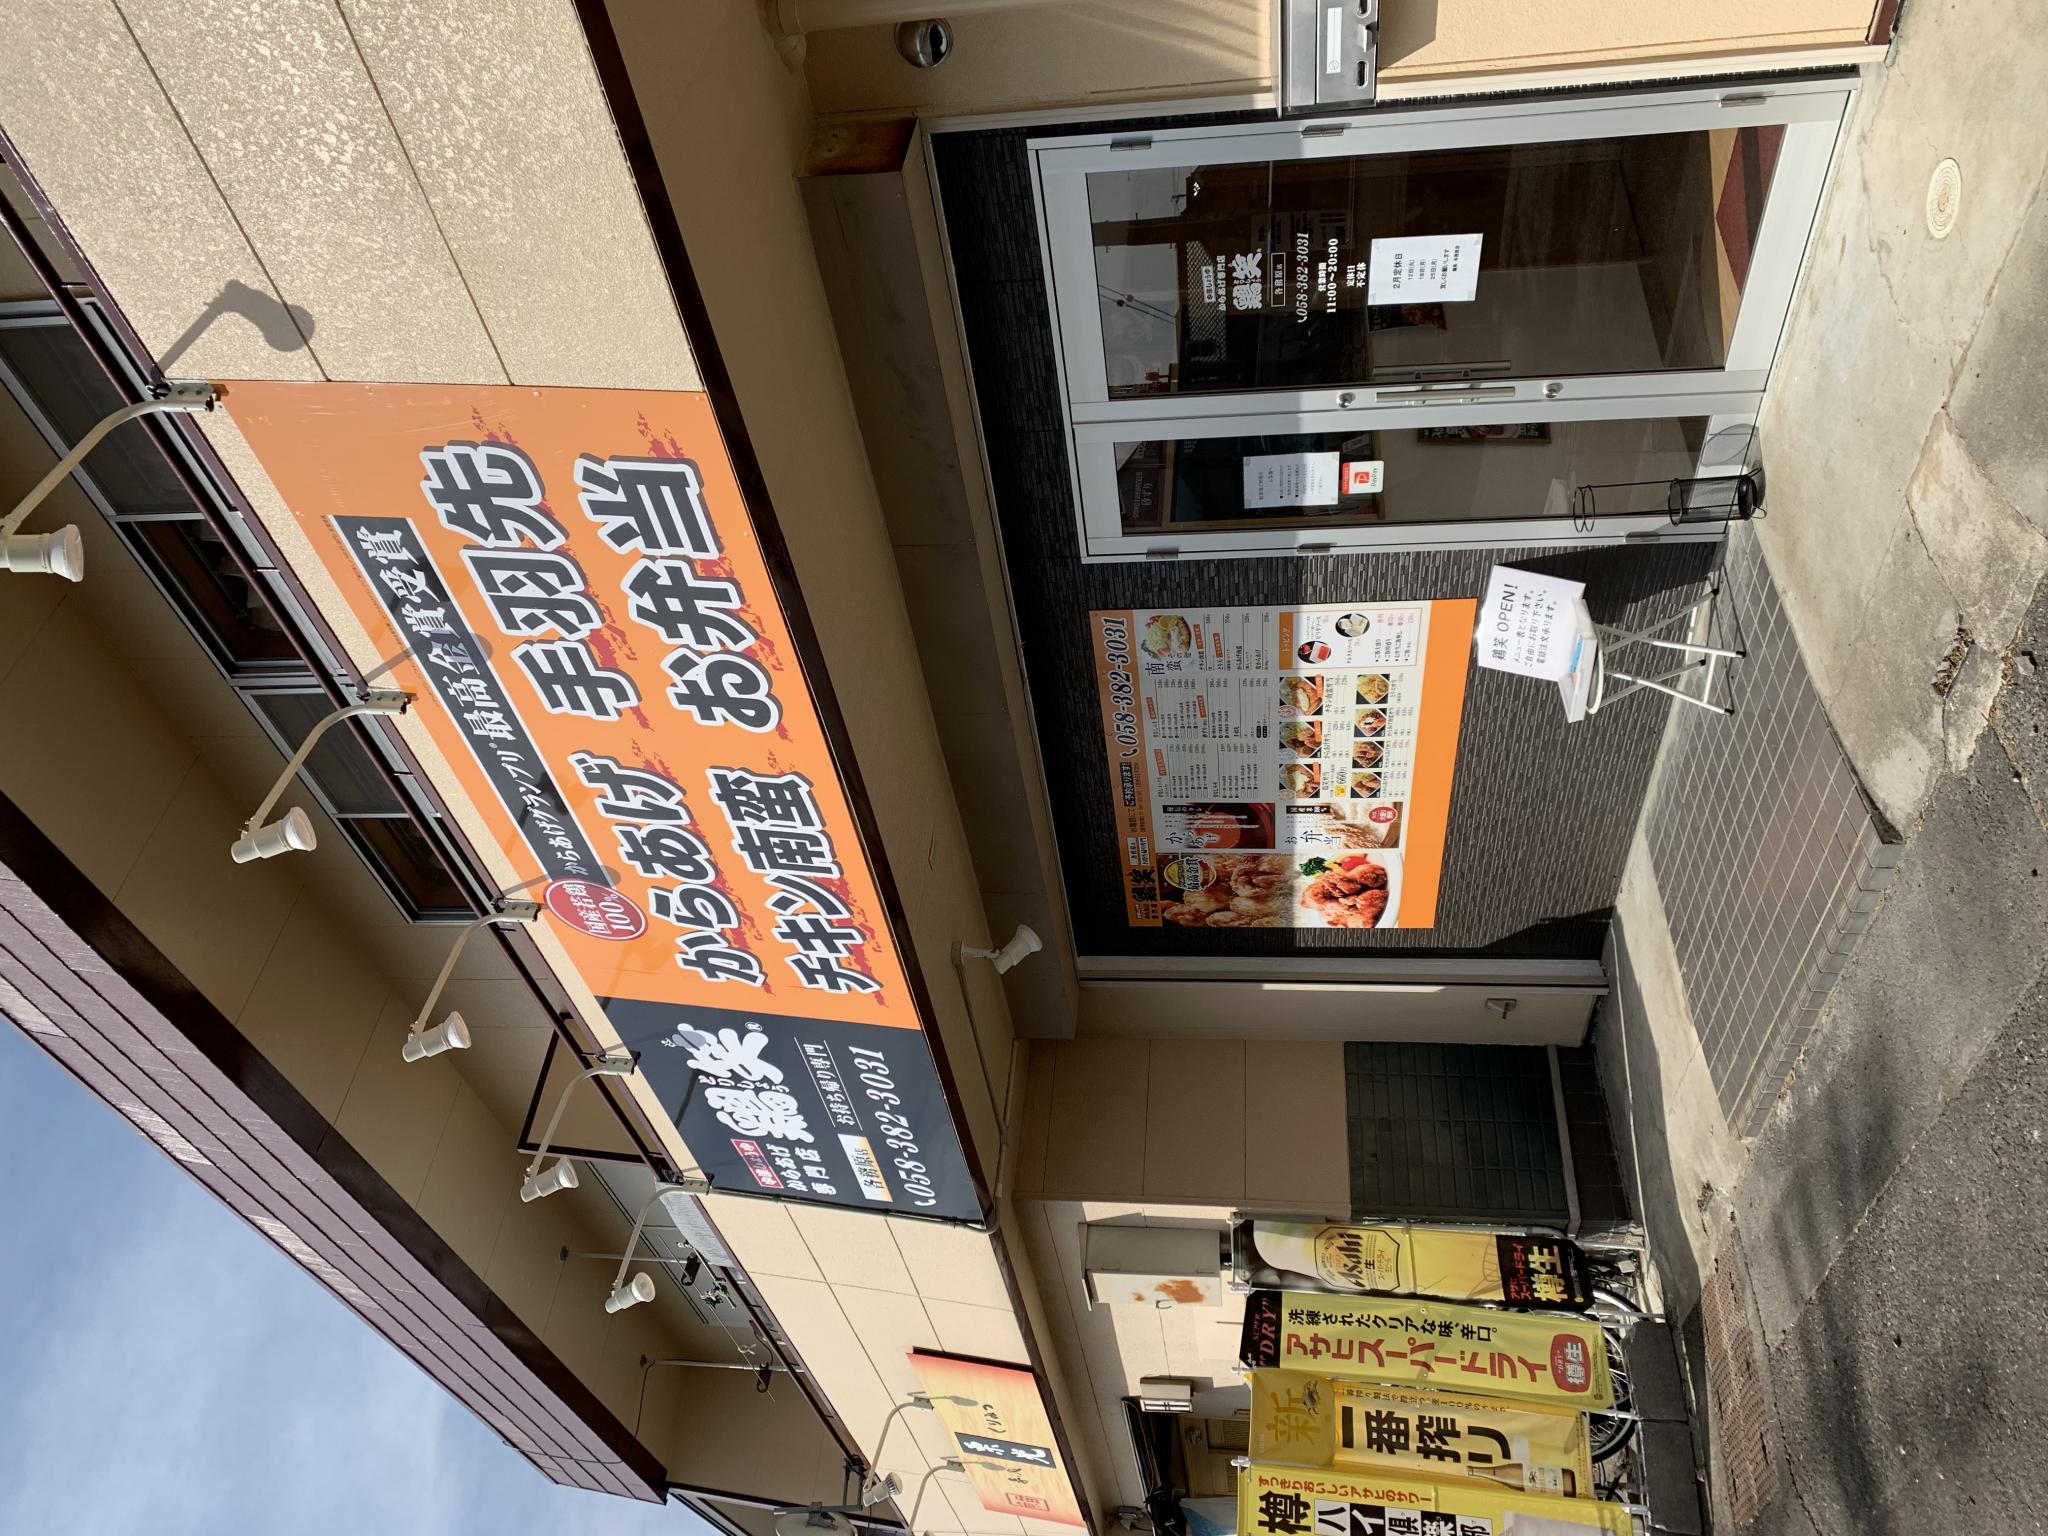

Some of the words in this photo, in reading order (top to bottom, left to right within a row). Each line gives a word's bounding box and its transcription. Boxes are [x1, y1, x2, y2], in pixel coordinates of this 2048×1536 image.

[1216, 255, 1226, 311] からあげ専門店
[1295, 232, 1309, 317] 058-382-3031
[1317, 261, 1327, 292] 営業時間
[1346, 264, 1356, 287] 定休日
[1356, 261, 1367, 289] 不定休
[1392, 253, 1403, 289] 2月定休日
[419, 445, 637, 721] 手羽先
[574, 456, 780, 733] お弁当
[1496, 583, 1519, 633] OPEN!
[1524, 589, 1547, 668] ご自由にお取り下さい。
[356, 526, 519, 741] 最高金賞受賞
[1281, 627, 1291, 653] トッピング
[1491, 637, 1509, 660] 鶏笑
[1102, 617, 1139, 746] 058-382-3031
[1145, 660, 1182, 676] 南蛮
[1164, 831, 1217, 847] からあげ
[1284, 829, 1342, 845] お弁当
[569, 751, 765, 986] からあげ
[707, 766, 881, 994] チキン南蛮
[1186, 857, 1200, 890] 最高金賞
[562, 884, 611, 934] 国産若鶏
[599, 892, 636, 932] 100%
[803, 1043, 855, 1125] お持ち帰り専門
[848, 1045, 935, 1197] 058-382-3031
[766, 1143, 808, 1192] からあげ
[795, 1147, 837, 1195] 専門店
[852, 1147, 885, 1189] 各務原店
[1335, 1232, 1366, 1288] Asahi
[1363, 1259, 1376, 1270] 生
[1513, 1242, 1533, 1301] スーパードライ
[1527, 1245, 1569, 1303] 樽生
[1510, 1277, 1521, 1300] アサヒ
[1252, 1313, 1261, 1342] SUPER
[1288, 1308, 1498, 1342] 洗練されたクリアな味、辛口。
[1286, 1332, 1548, 1383] アサヒスーパードライ
[1564, 1342, 1587, 1385] 樽生
[982, 1404, 1006, 1433] くりみつ
[1265, 1388, 1321, 1446] 新
[1341, 1405, 1511, 1464] 一番搾り
[1258, 1475, 1432, 1504] すっきりおいしいアサヒのサワー
